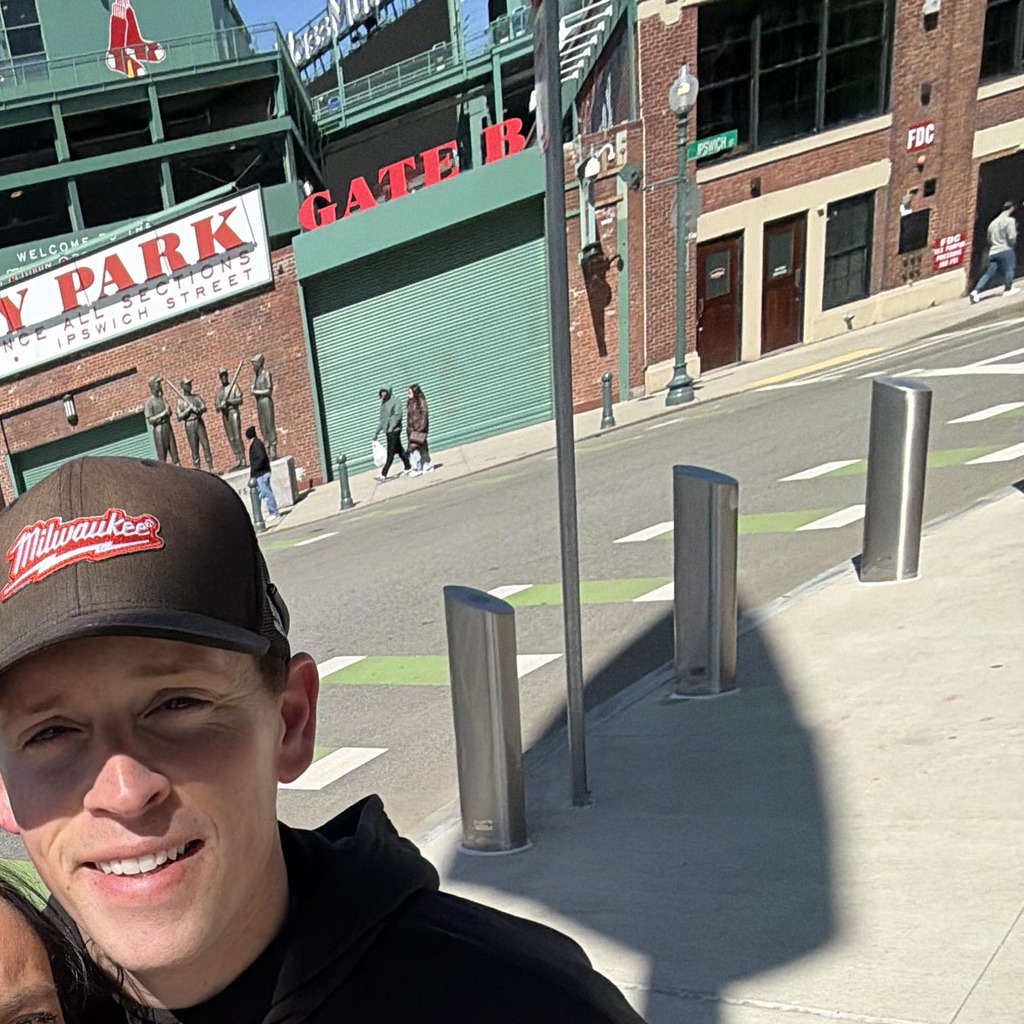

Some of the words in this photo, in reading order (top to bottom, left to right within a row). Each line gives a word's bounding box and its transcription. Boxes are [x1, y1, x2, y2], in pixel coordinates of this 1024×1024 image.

[297, 139, 462, 231] GATE
[481, 117, 527, 165] B
[906, 123, 935, 150] FDC
[17, 237, 89, 262] WELCOME
[54, 206, 246, 313] PARK
[57, 307, 149, 349] IPSWICH
[166, 268, 253, 310] STREET
[63, 304, 104, 331] ALL
[121, 251, 251, 309] SECTIONS
[9, 511, 153, 575] Milwaukee
